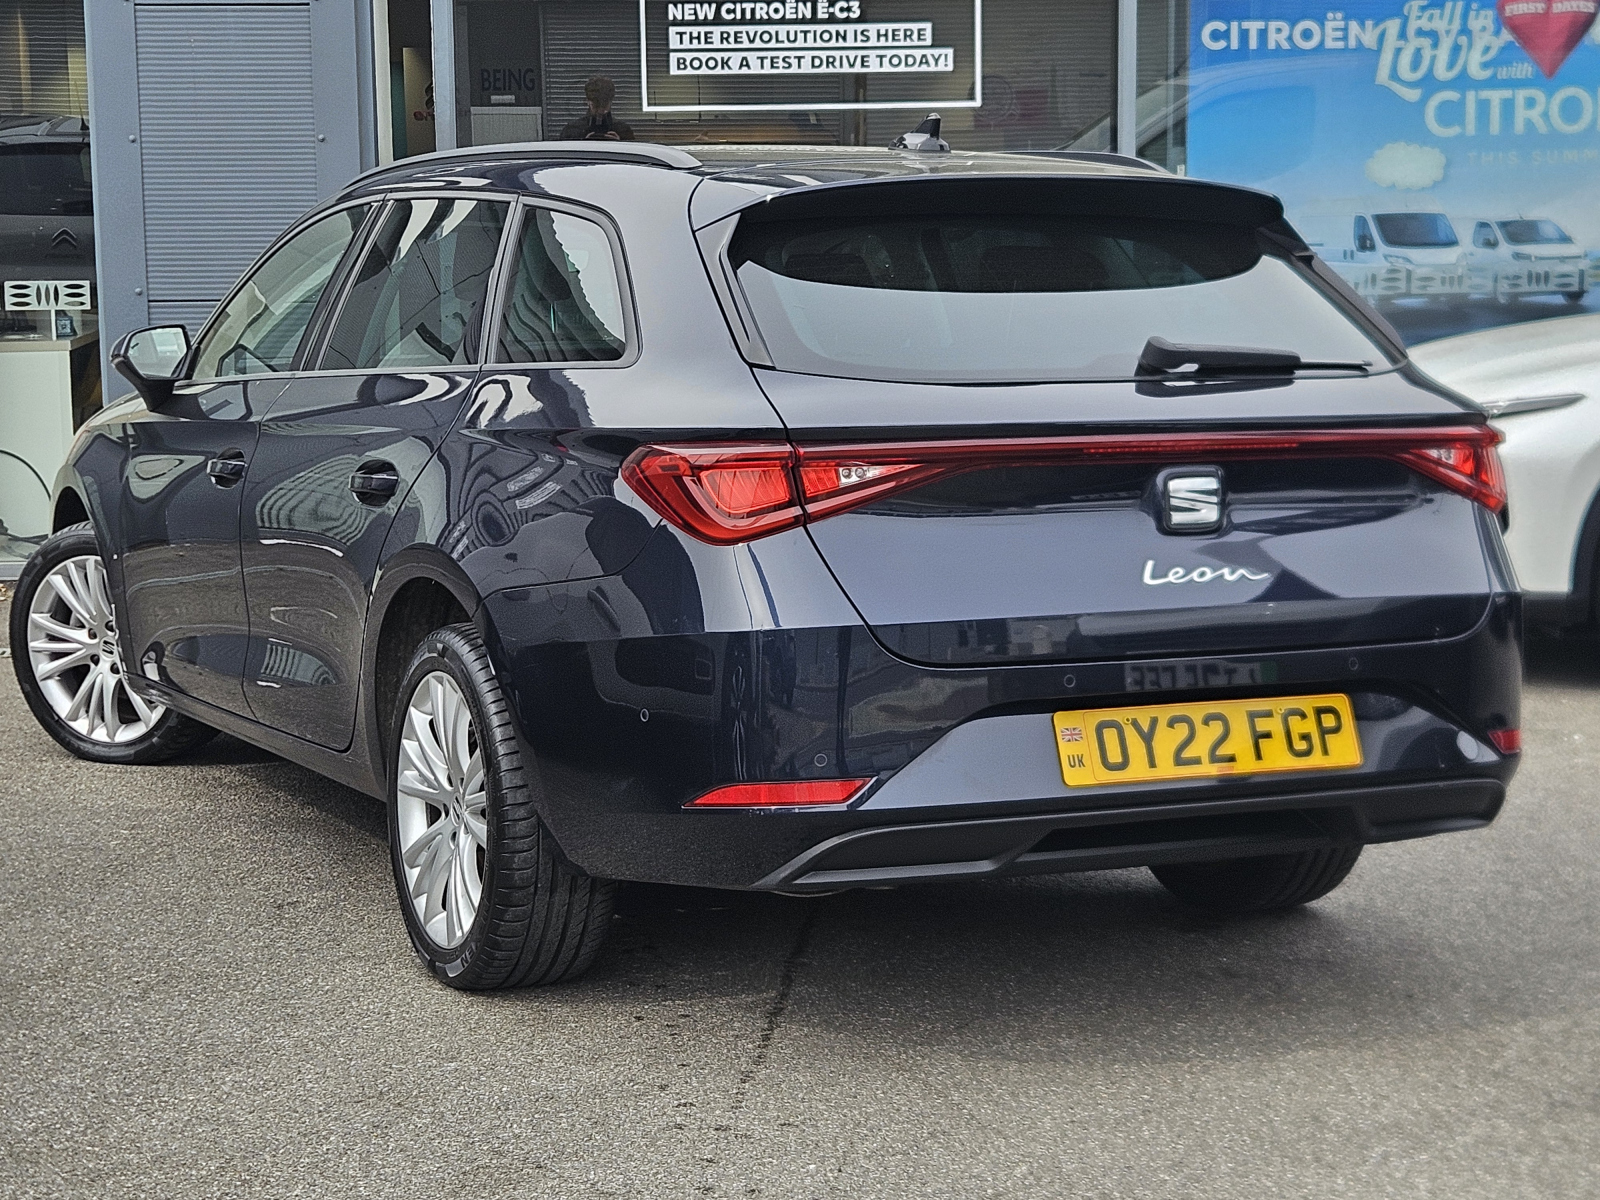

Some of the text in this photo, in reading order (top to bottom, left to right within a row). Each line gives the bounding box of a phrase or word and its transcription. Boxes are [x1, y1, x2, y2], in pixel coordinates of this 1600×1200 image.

[667, 0, 861, 21] NEW CITROËN Ë-C3
[1404, 0, 1464, 30] Fall
[1505, 2, 1545, 16] FIRST
[674, 27, 929, 46] THE REVOLUTION IS HERE
[1201, 12, 1378, 51] CITROËN
[676, 52, 950, 71] BOOK A TEST DRIVE TODAY!
[1370, 18, 1499, 103] Love
[1496, 62, 1534, 80] with
[480, 67, 536, 92] BEING
[1424, 85, 1600, 138] CITRO
[1467, 150, 1518, 166] THIS
[1143, 560, 1270, 585] Leon
[1095, 705, 1344, 773] OY22 FGP
[1066, 753, 1086, 769] UK
